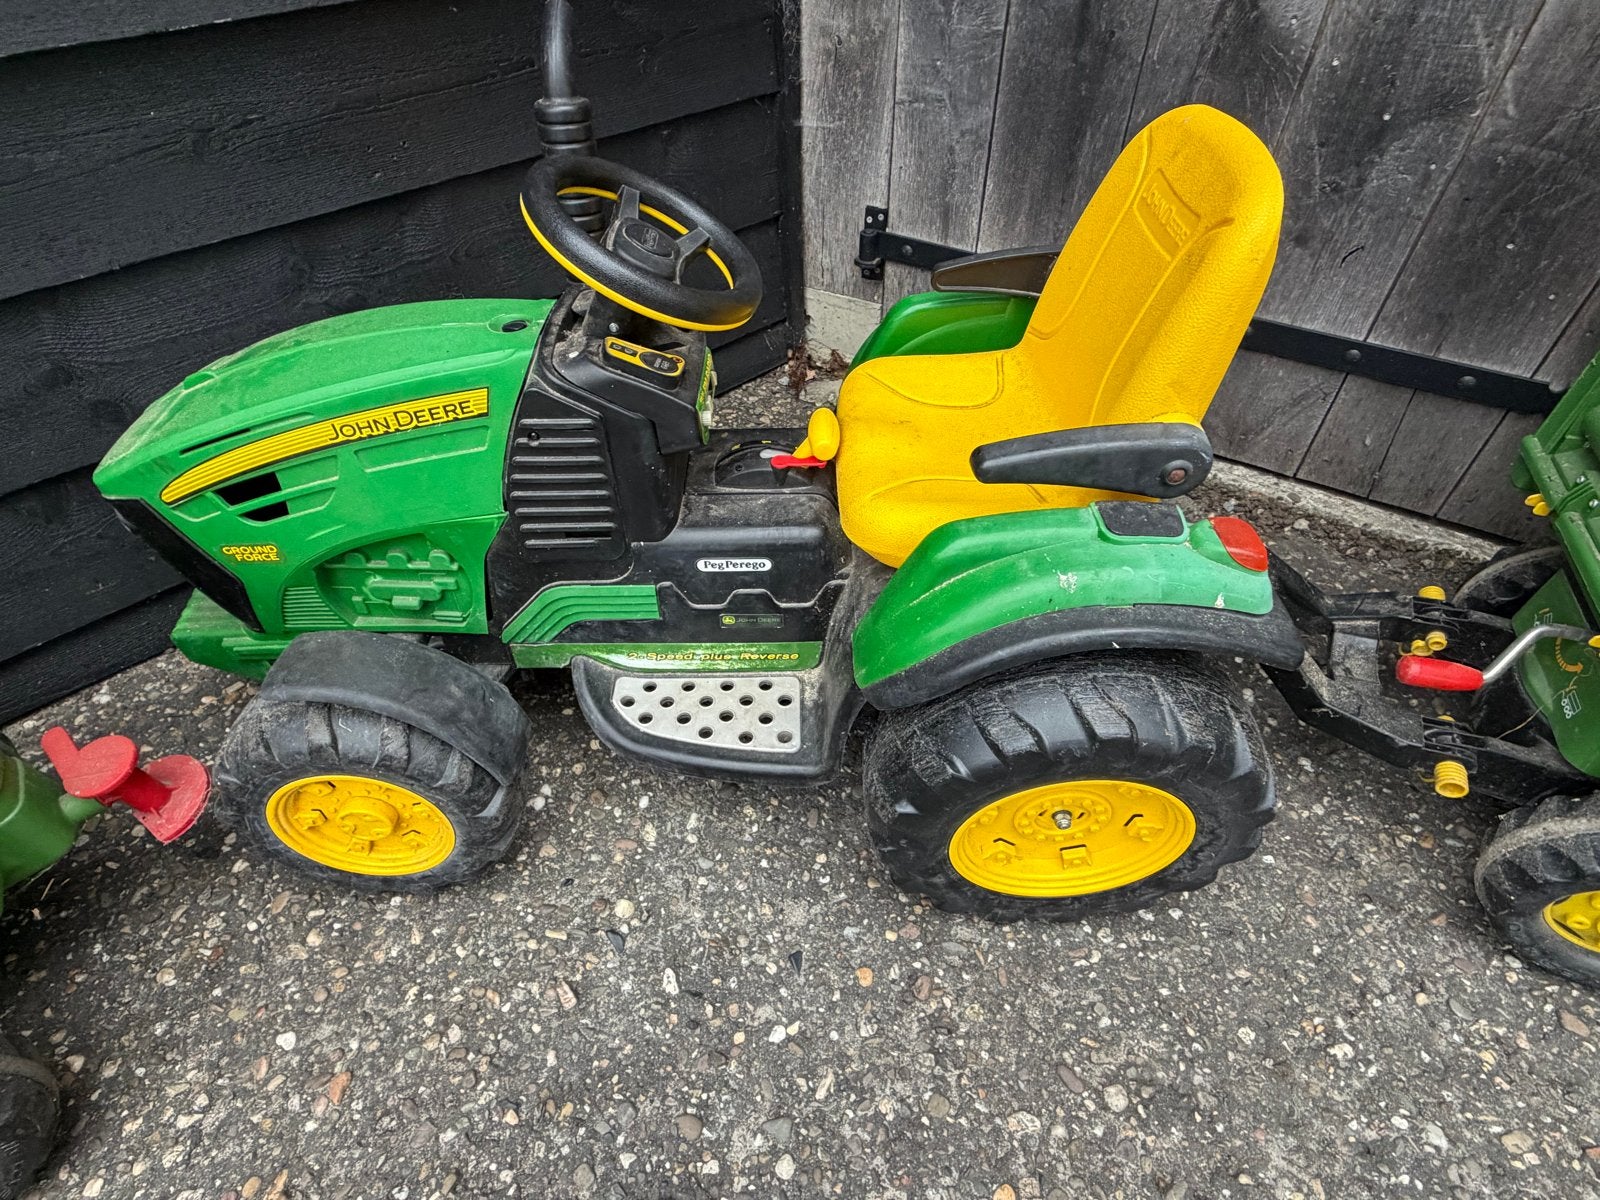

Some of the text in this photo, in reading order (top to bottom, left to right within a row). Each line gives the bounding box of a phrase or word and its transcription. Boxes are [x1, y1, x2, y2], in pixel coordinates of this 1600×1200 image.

[328, 400, 475, 441] JOHN DEERE
[222, 545, 277, 555] GROUND
[235, 553, 280, 561] FORCE
[701, 652, 732, 661] plus
[740, 652, 799, 661] Reverse
